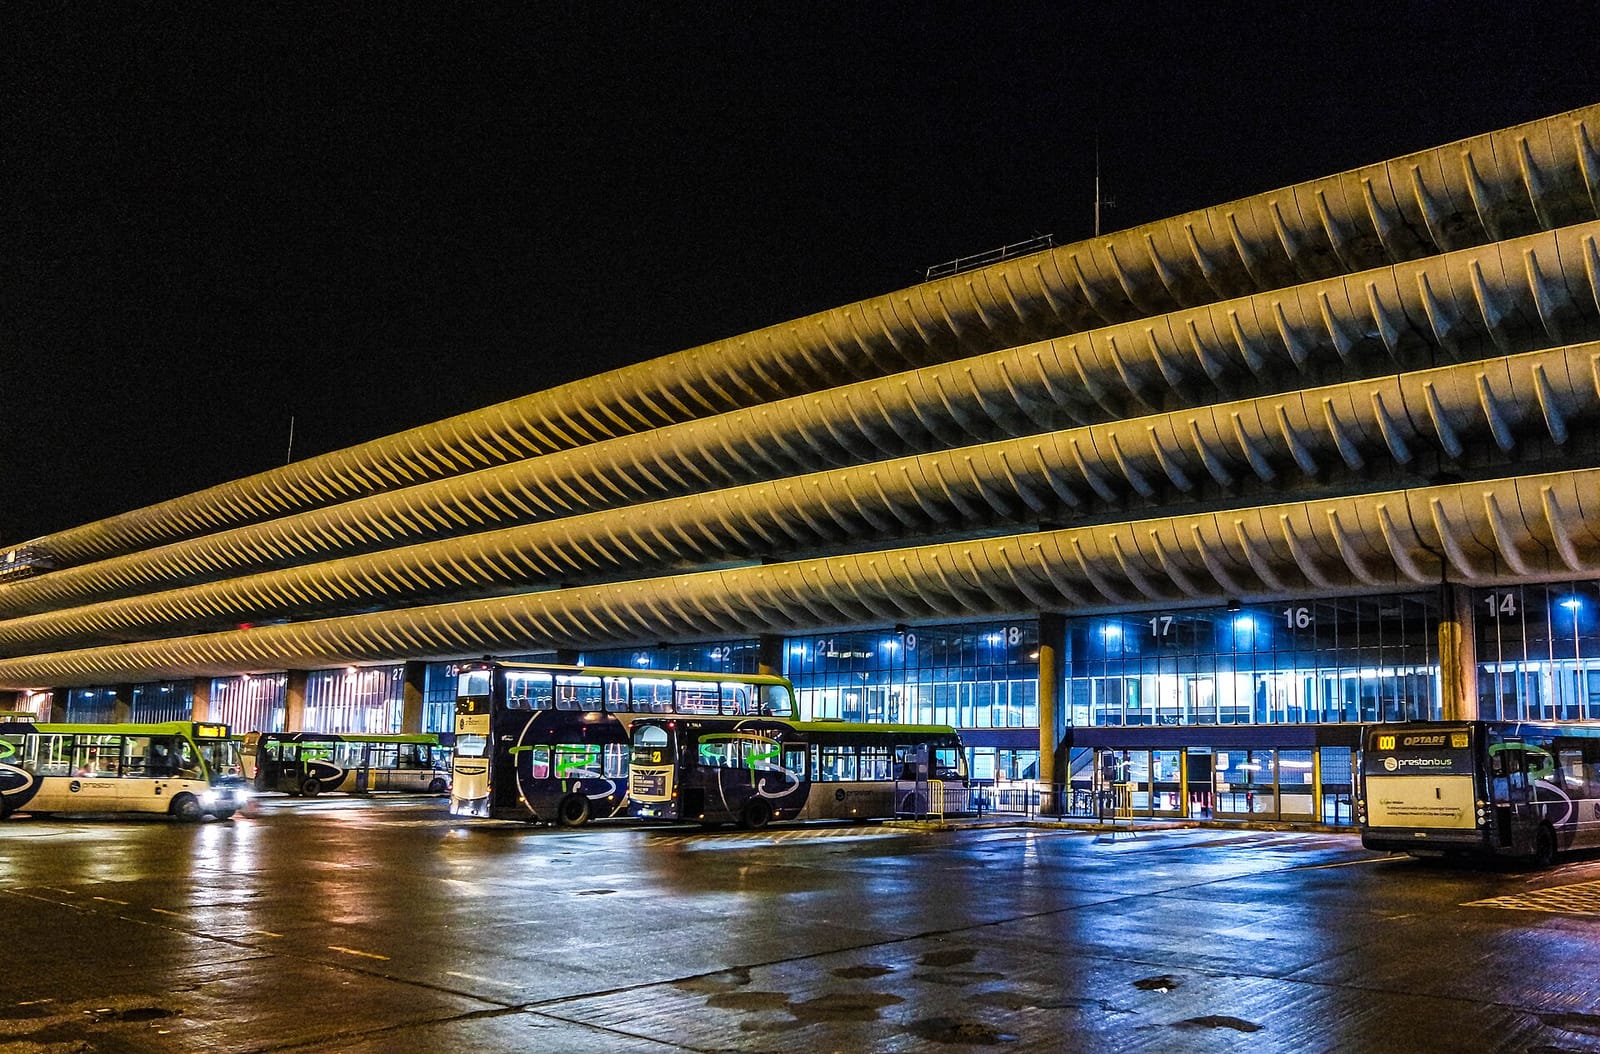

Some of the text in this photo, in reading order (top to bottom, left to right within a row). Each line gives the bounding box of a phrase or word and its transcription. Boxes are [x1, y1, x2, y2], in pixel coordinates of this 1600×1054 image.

[1484, 593, 1517, 617] 14
[1149, 616, 1173, 637] 17
[1283, 607, 1310, 629] 16
[899, 633, 916, 651] 19
[1000, 626, 1020, 646] 18
[817, 639, 834, 656] 21
[392, 667, 404, 681] 27
[1403, 735, 1446, 746] OPTARE
